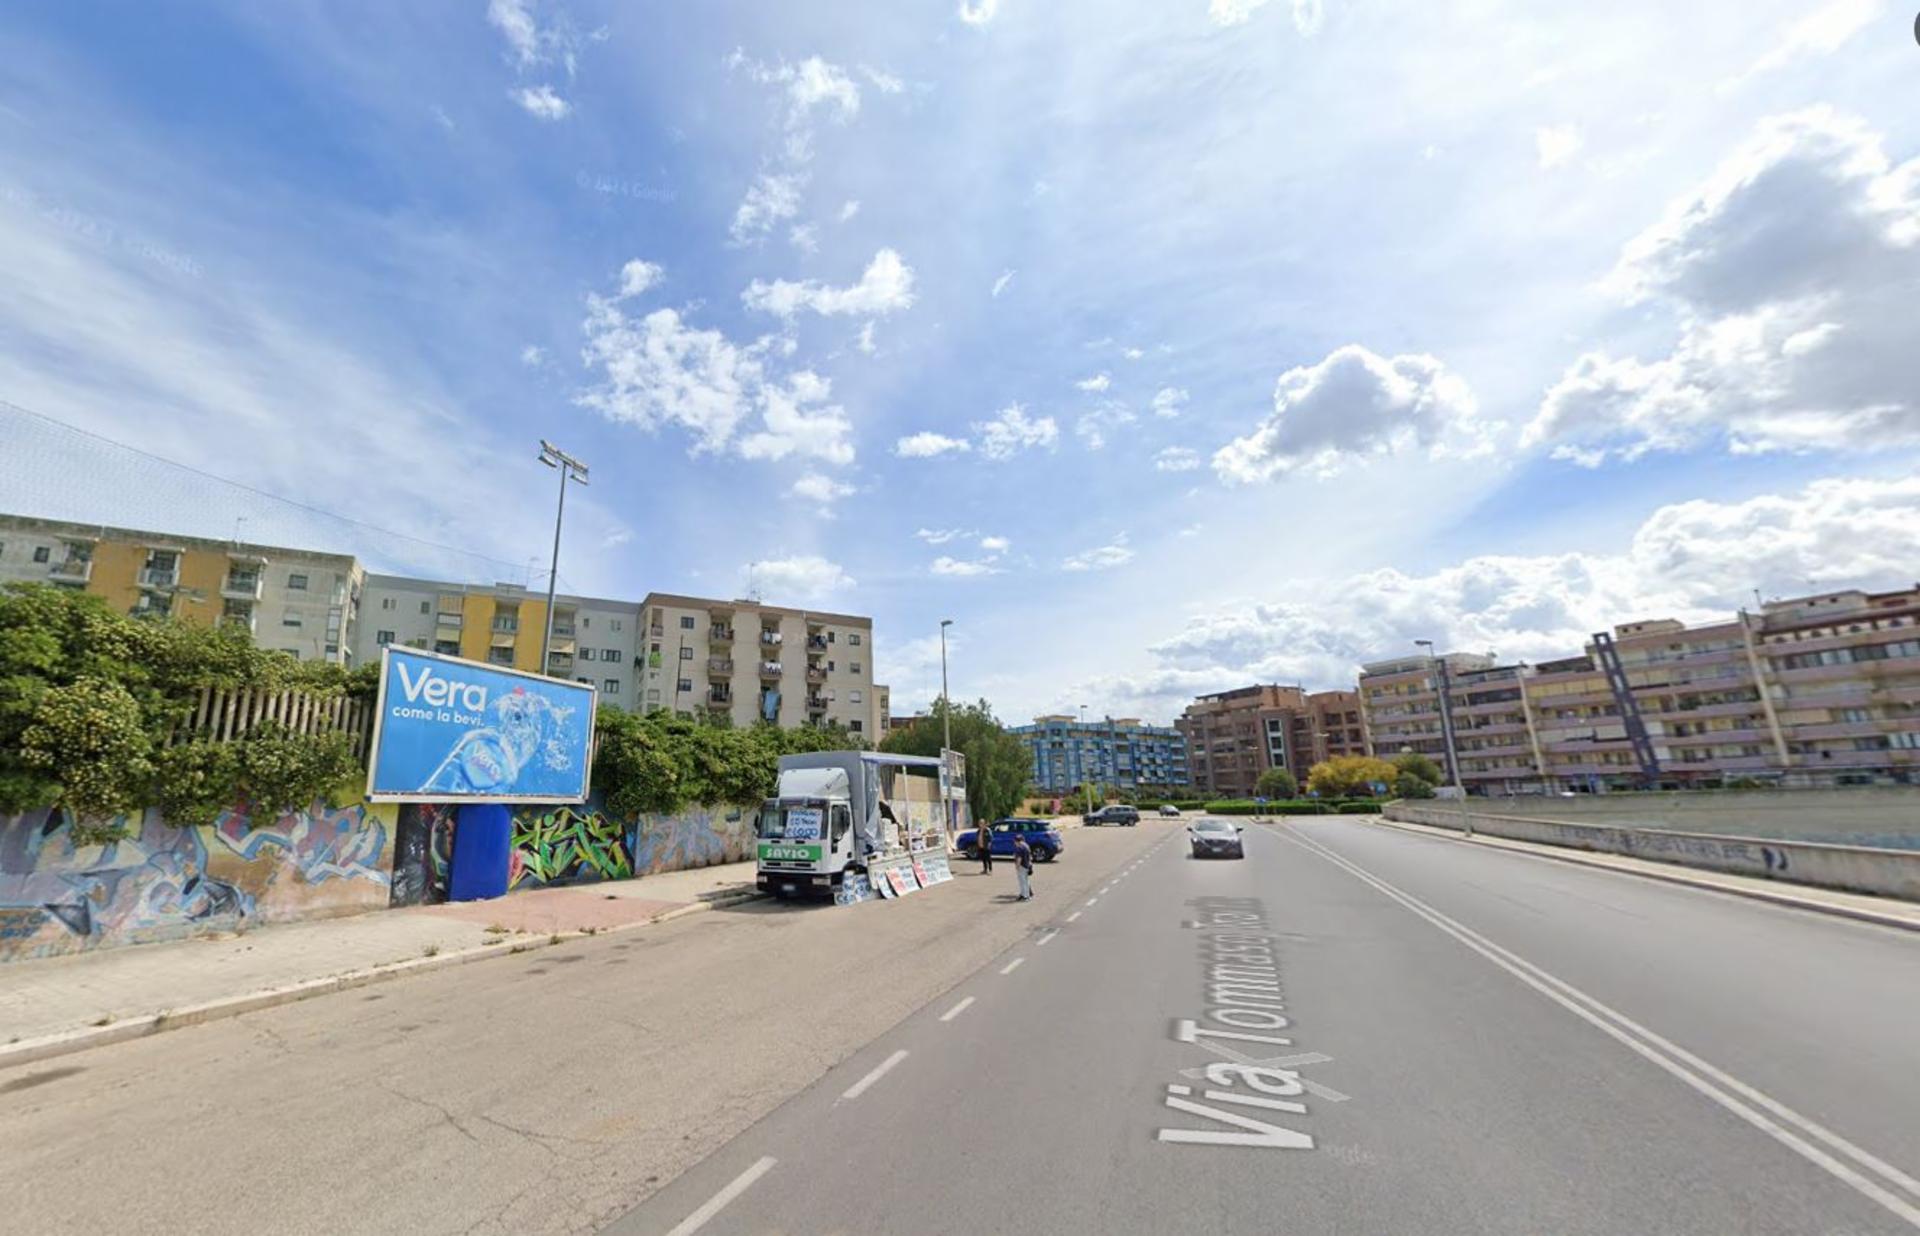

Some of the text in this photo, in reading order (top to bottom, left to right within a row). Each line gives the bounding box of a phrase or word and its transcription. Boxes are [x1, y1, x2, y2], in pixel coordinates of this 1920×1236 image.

[397, 662, 487, 712] Vera
[392, 706, 433, 720] come
[437, 708, 450, 722] la
